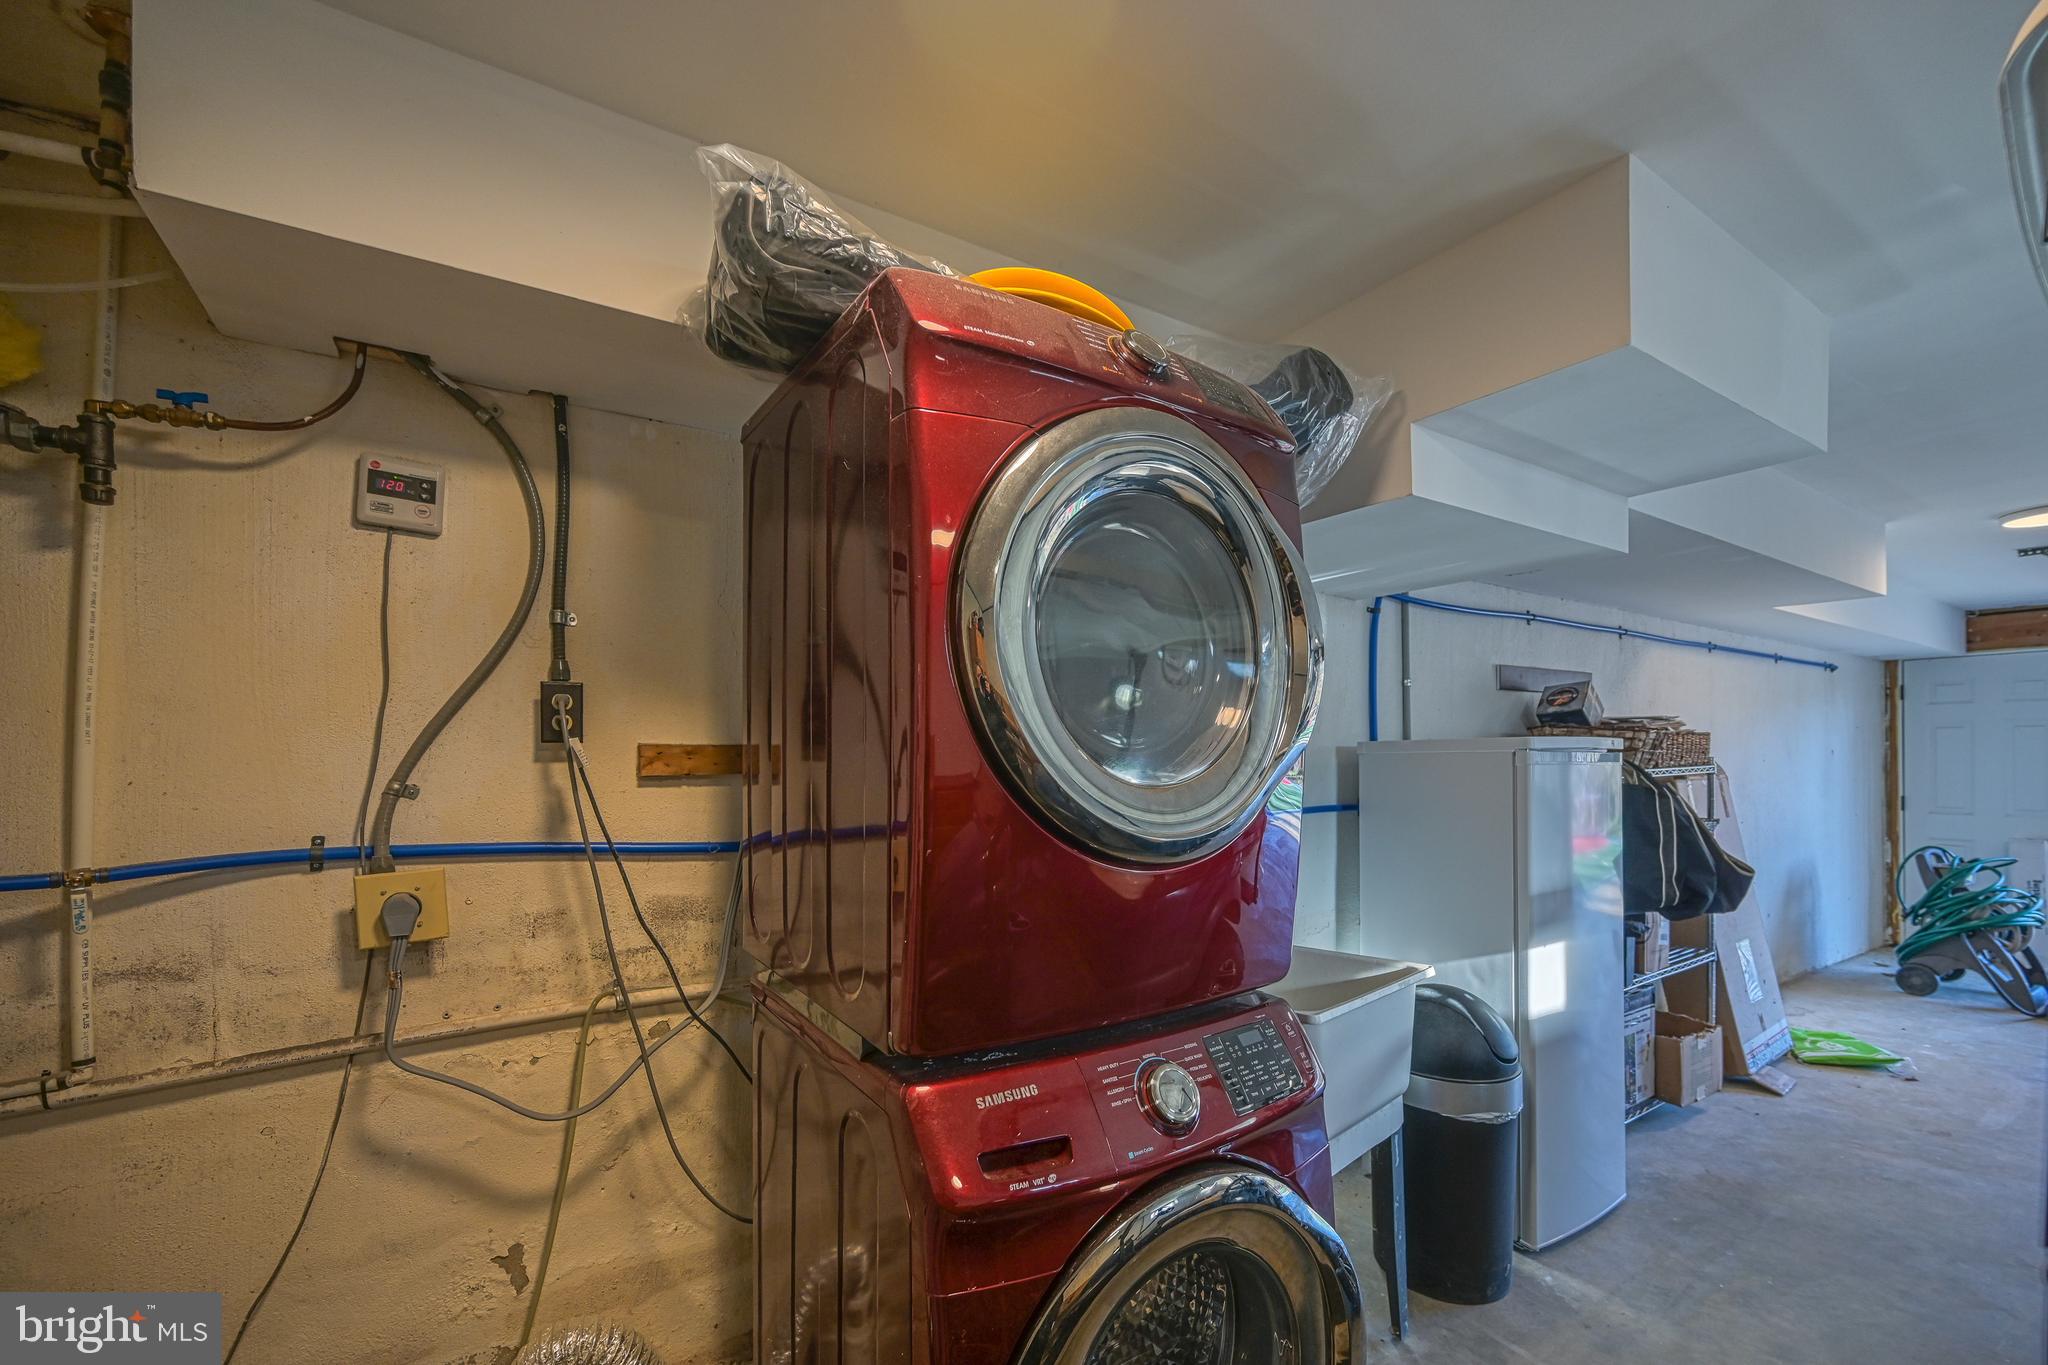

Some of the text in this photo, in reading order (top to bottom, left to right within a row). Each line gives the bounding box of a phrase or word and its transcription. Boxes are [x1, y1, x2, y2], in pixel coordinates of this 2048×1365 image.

[380, 480, 404, 492] 120
[976, 1084, 1039, 1109] SAMSUNG
[1009, 1181, 1030, 1191] STEAM
